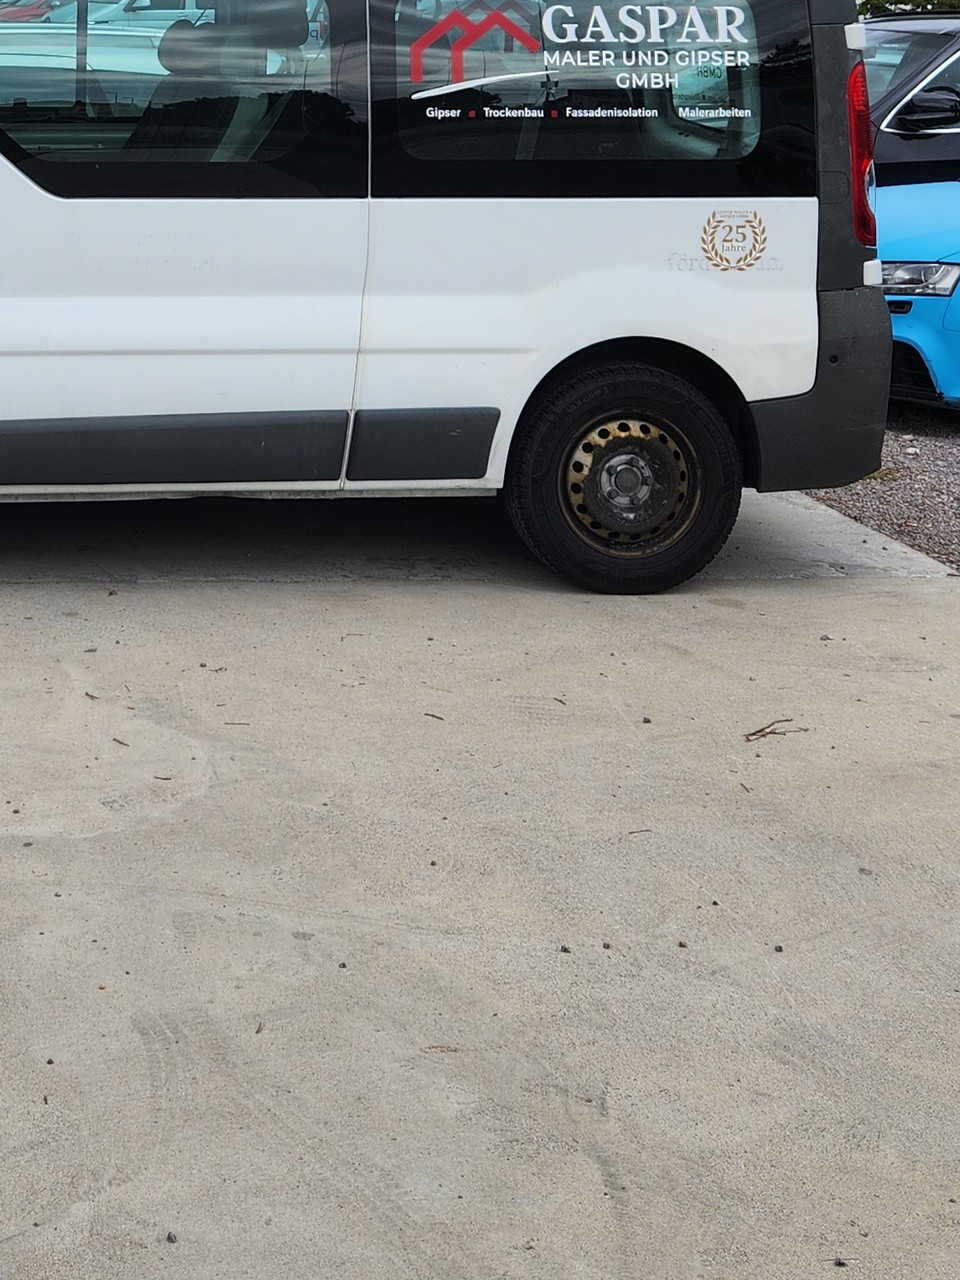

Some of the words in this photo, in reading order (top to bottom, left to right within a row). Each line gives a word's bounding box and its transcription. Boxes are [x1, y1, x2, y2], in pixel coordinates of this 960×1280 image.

[542, 4, 748, 44] GASPAR
[543, 51, 615, 67] MALER
[622, 51, 669, 67] UND
[675, 50, 750, 68] GIPSER
[615, 73, 679, 89] GMBH
[426, 107, 461, 120] Gipser
[483, 107, 545, 118] Trockenbau
[565, 107, 658, 118] Fassadenisolation
[678, 107, 751, 118] Malerarbeiten
[721, 224, 747, 243] 25
[721, 244, 747, 253] Jahre
